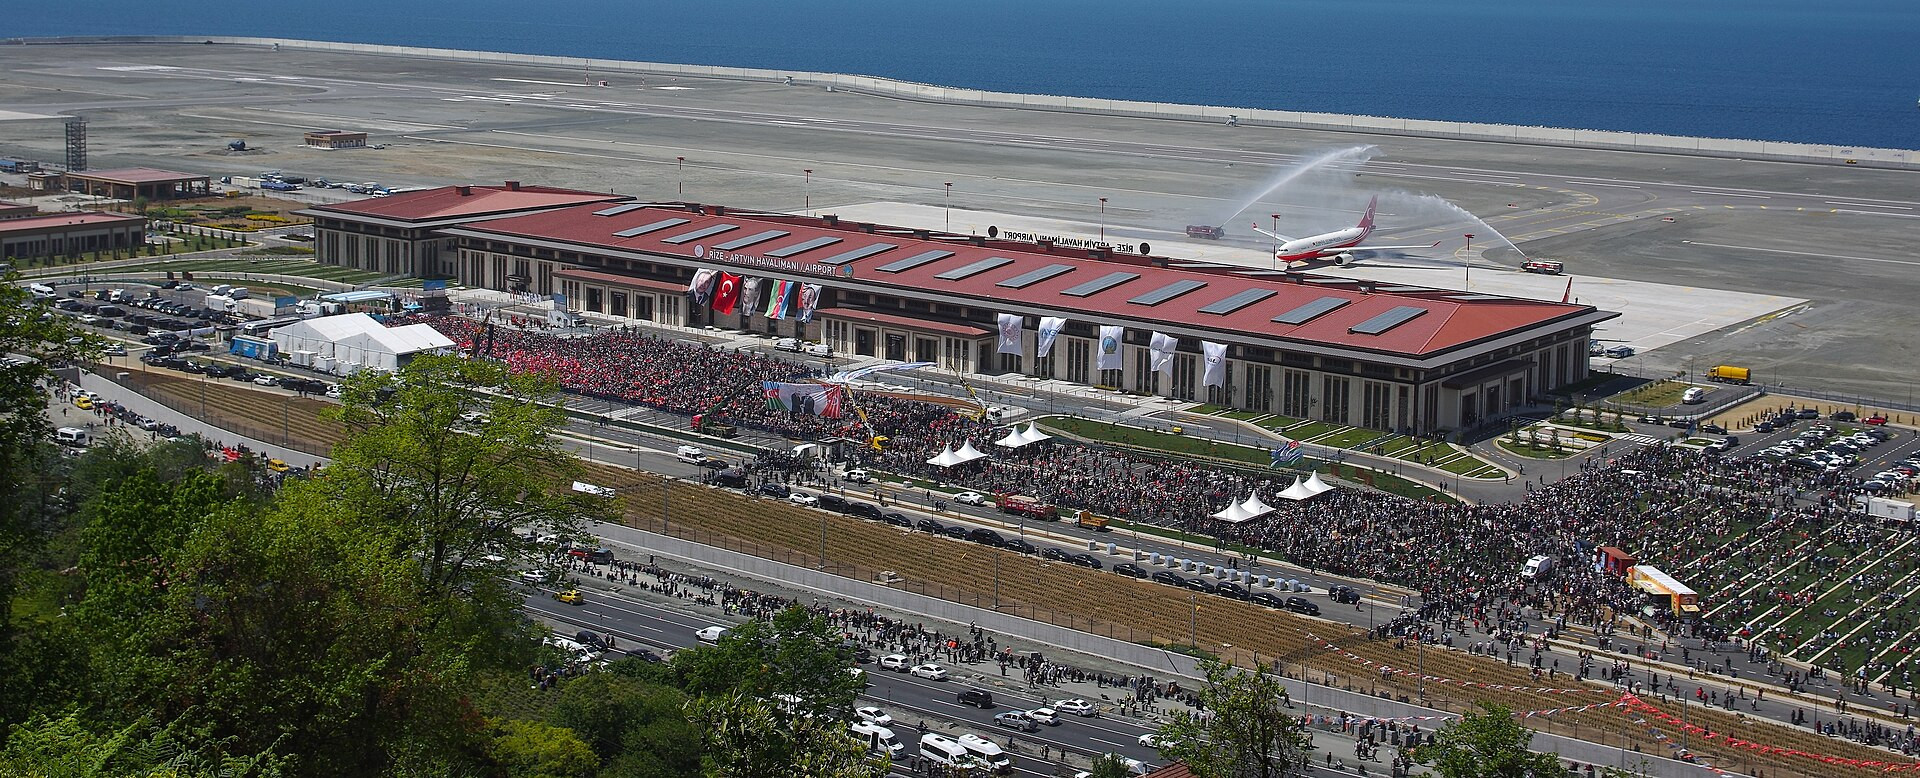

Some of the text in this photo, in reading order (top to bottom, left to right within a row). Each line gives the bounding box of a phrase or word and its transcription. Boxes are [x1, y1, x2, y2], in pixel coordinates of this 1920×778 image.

[709, 250, 724, 260] RİZE
[730, 253, 755, 265] ARTVİN
[756, 256, 799, 271] HAVALİMANI
[805, 263, 836, 276] AIRPORT
